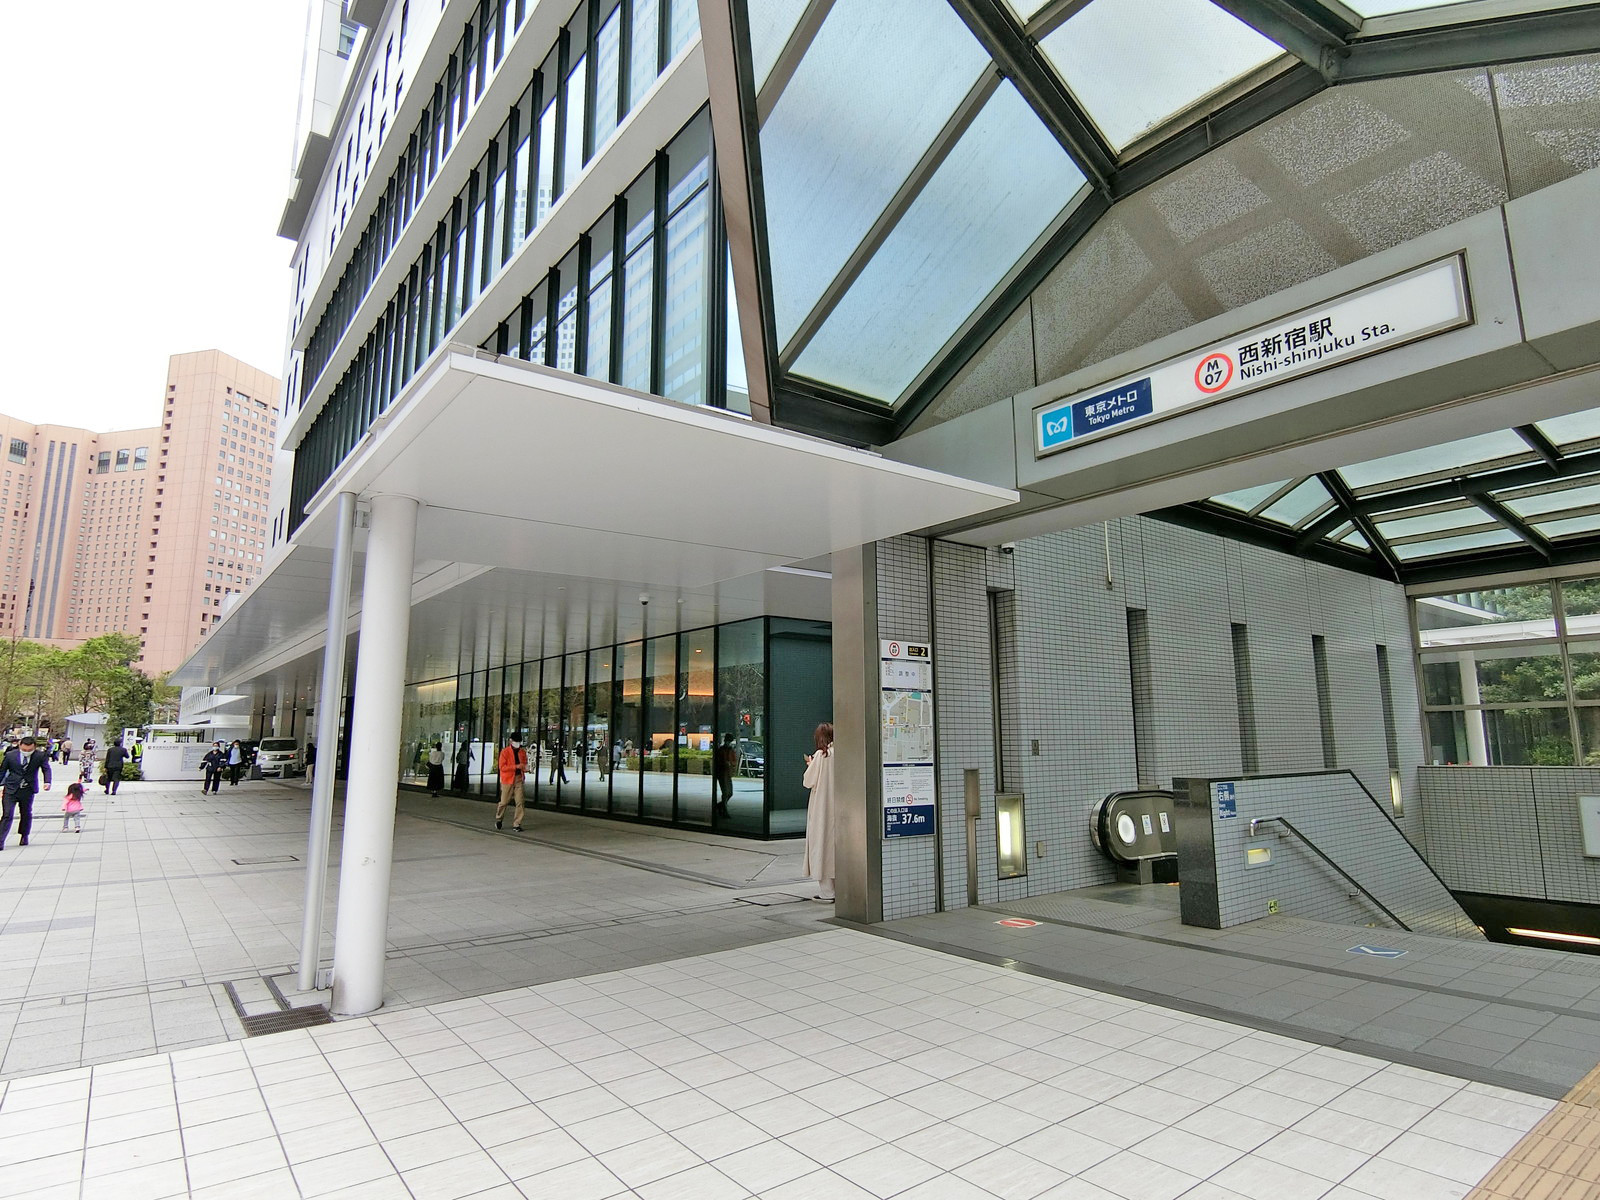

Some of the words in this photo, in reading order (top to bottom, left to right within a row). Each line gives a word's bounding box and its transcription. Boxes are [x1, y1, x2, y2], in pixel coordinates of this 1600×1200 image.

[1238, 317, 1334, 367] 西新宿駅
[1240, 334, 1355, 381] Nishi-shinjuku
[1361, 323, 1396, 341] Sta.
[1206, 359, 1220, 373] M
[1204, 370, 1223, 386] 07
[1084, 389, 1138, 418] 東京メトロ
[1088, 412, 1111, 426] Tokyo
[1111, 404, 1135, 418] Metro
[920, 647, 926, 657] 2
[901, 813, 926, 825] 37.6m
